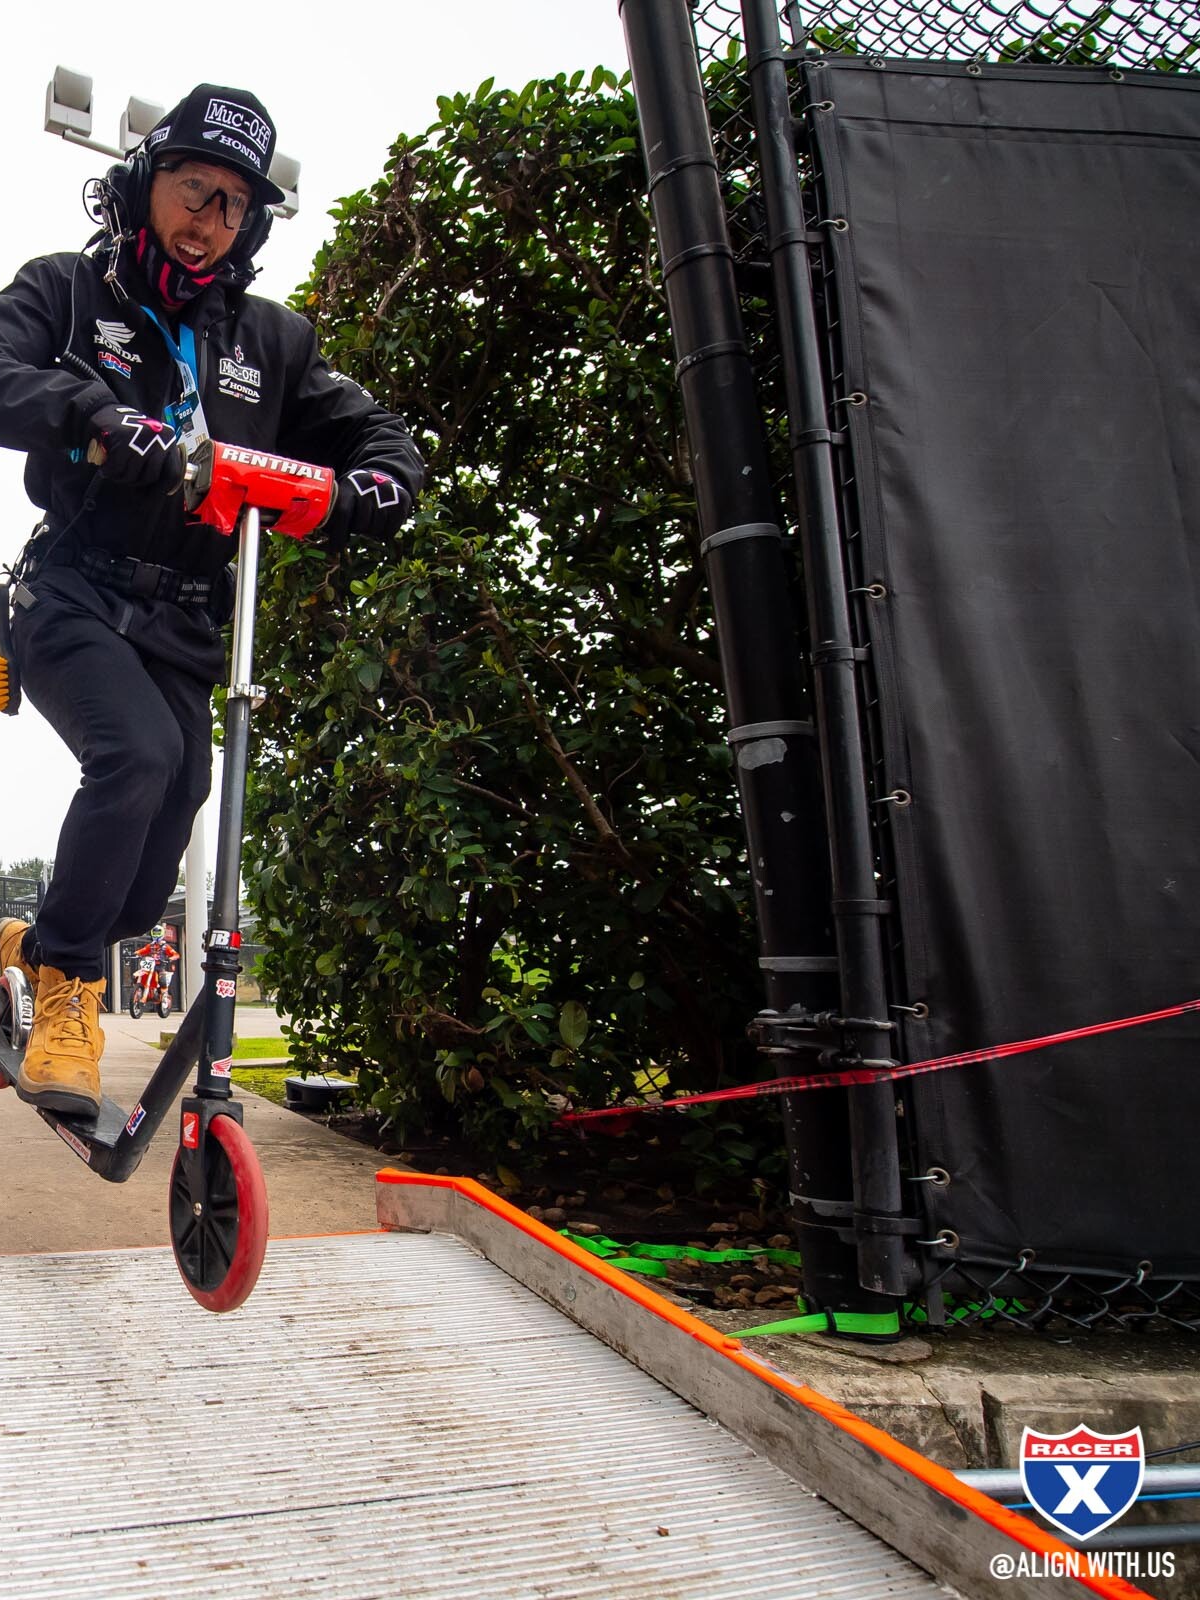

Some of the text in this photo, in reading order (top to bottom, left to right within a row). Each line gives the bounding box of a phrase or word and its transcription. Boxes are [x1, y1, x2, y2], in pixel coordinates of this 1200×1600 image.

[219, 135, 261, 169] HONDA
[93, 335, 143, 363] HONDA
[98, 351, 132, 379] HRC
[230, 382, 260, 398] HONDA
[179, 408, 193, 420] 2021
[221, 447, 327, 482] RENTHAL
[217, 980, 234, 988] RIDE
[217, 986, 235, 996] RED
[126, 1104, 145, 1134] HRC
